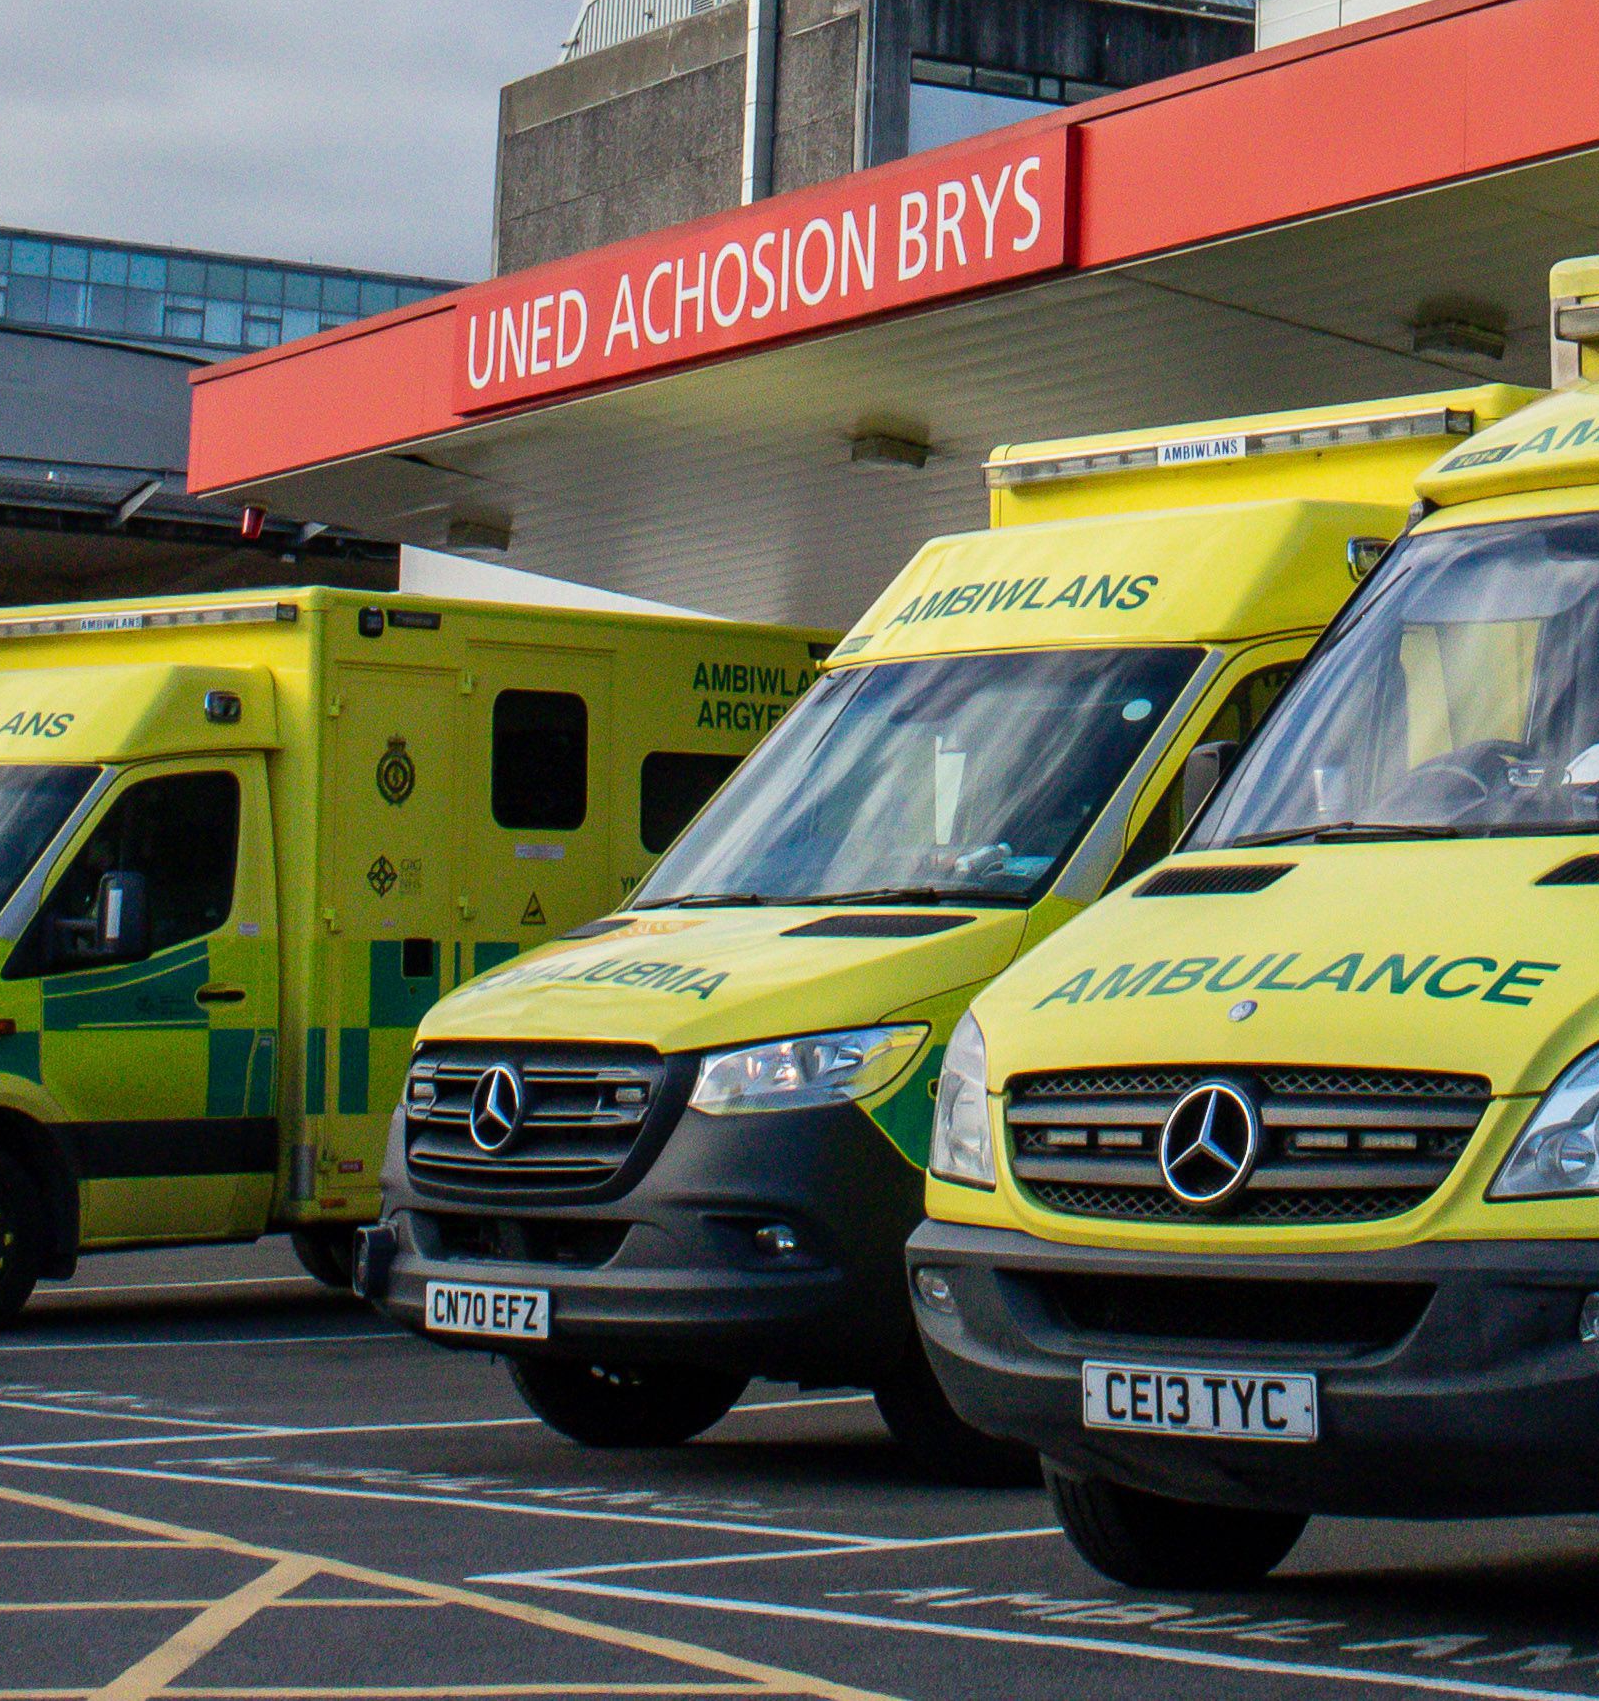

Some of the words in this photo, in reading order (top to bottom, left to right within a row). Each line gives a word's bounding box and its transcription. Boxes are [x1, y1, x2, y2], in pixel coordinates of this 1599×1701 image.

[467, 289, 588, 390] UNED
[604, 204, 877, 357] ACHOSION
[898, 156, 1041, 281] BRYS
[1164, 438, 1239, 462] AMBIWLANS
[81, 617, 142, 631] AMBIWLANS
[884, 574, 1159, 630] AMBIWLANS
[1030, 952, 1562, 1011] AMBULANCE
[434, 1287, 487, 1327] CN70
[492, 1293, 538, 1331] EFZ
[1105, 1371, 1191, 1425] CE13
[1202, 1377, 1288, 1430] TYC
